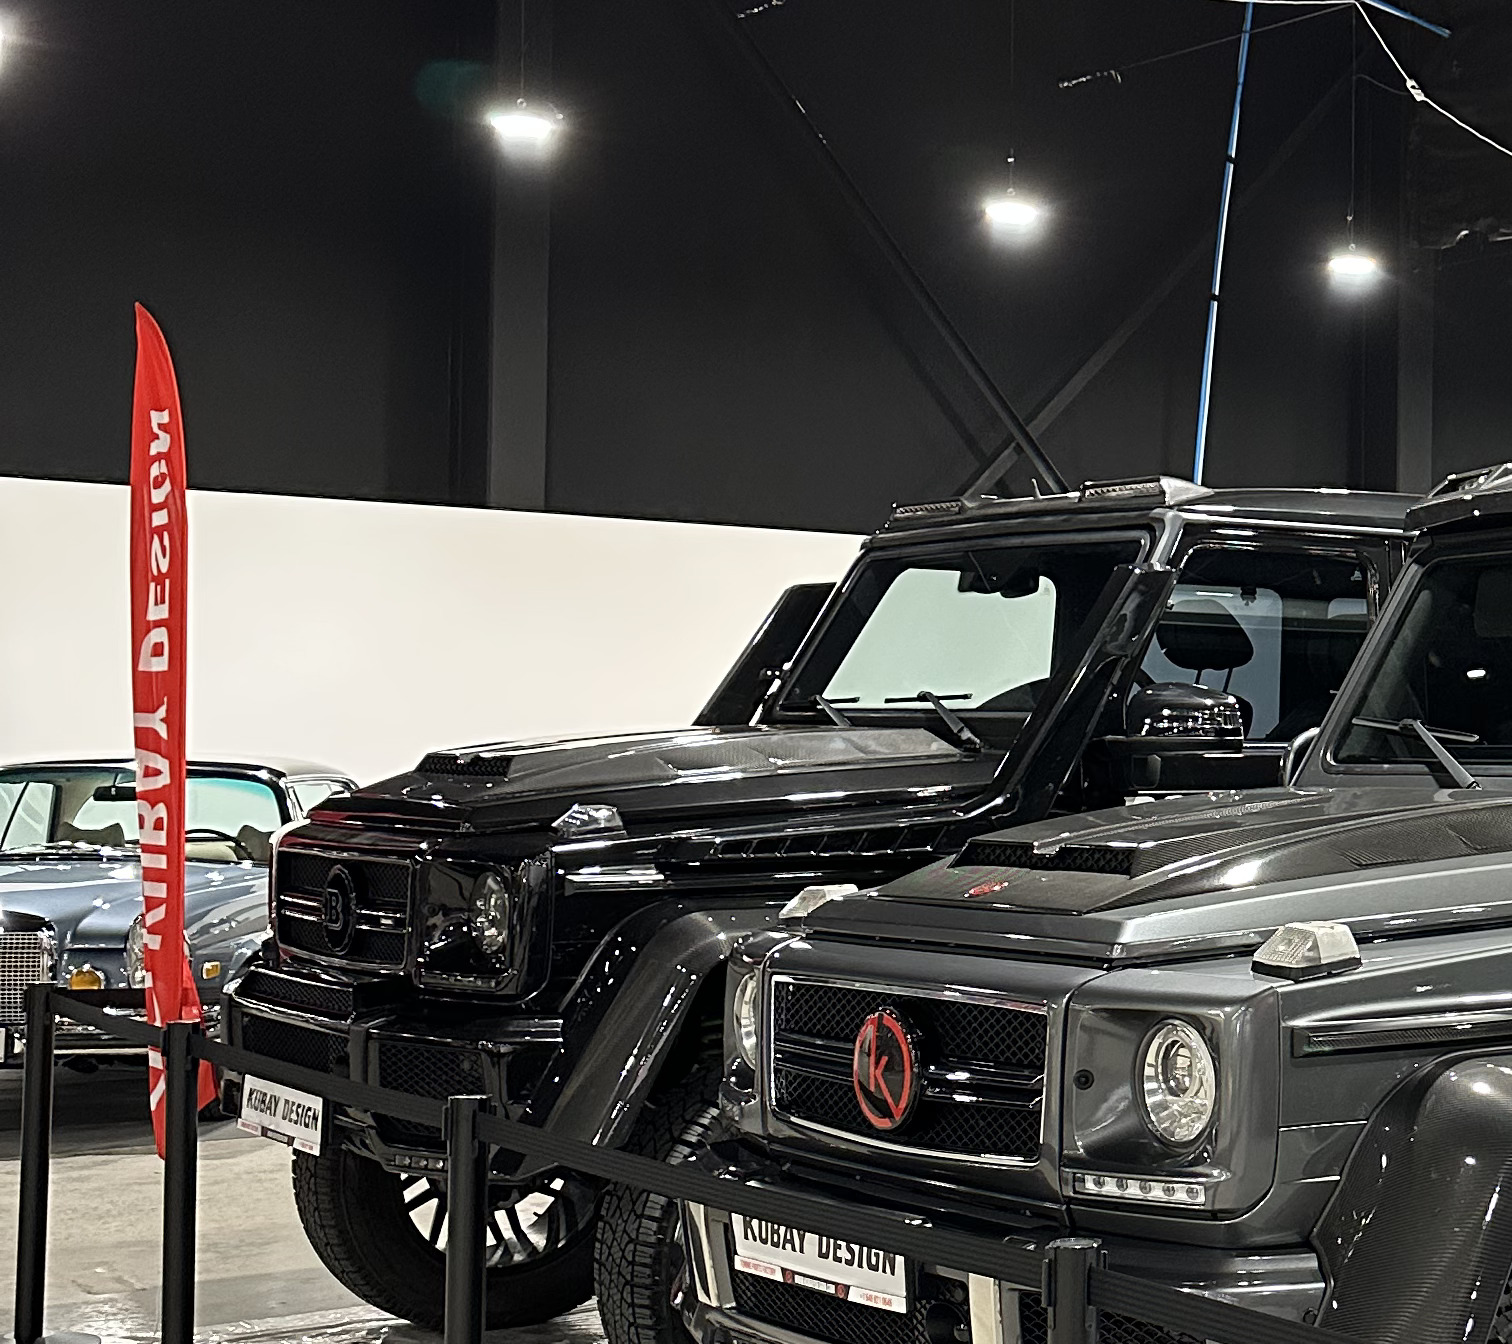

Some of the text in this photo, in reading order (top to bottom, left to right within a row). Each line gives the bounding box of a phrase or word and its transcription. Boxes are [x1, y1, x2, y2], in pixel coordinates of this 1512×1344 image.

[246, 1087, 320, 1131] KUBAY DESIGN
[742, 1215, 806, 1255] KUBAY
[817, 1234, 897, 1277] DESIGN
